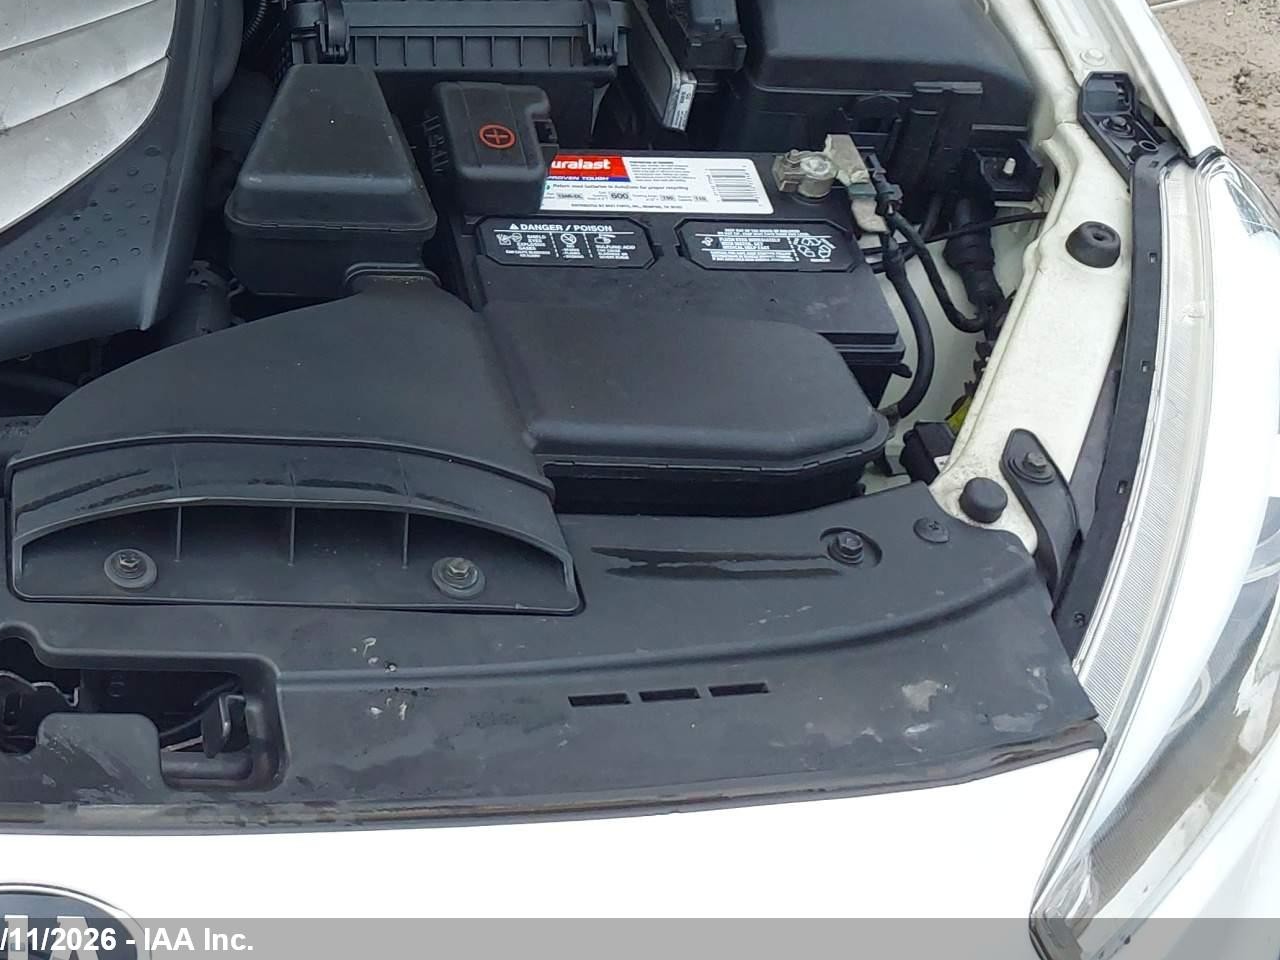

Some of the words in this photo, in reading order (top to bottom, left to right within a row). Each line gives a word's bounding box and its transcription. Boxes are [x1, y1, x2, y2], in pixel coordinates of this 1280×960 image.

[550, 158, 611, 170] uralast
[520, 224, 563, 232] DANGER
[573, 225, 613, 233] POISON
